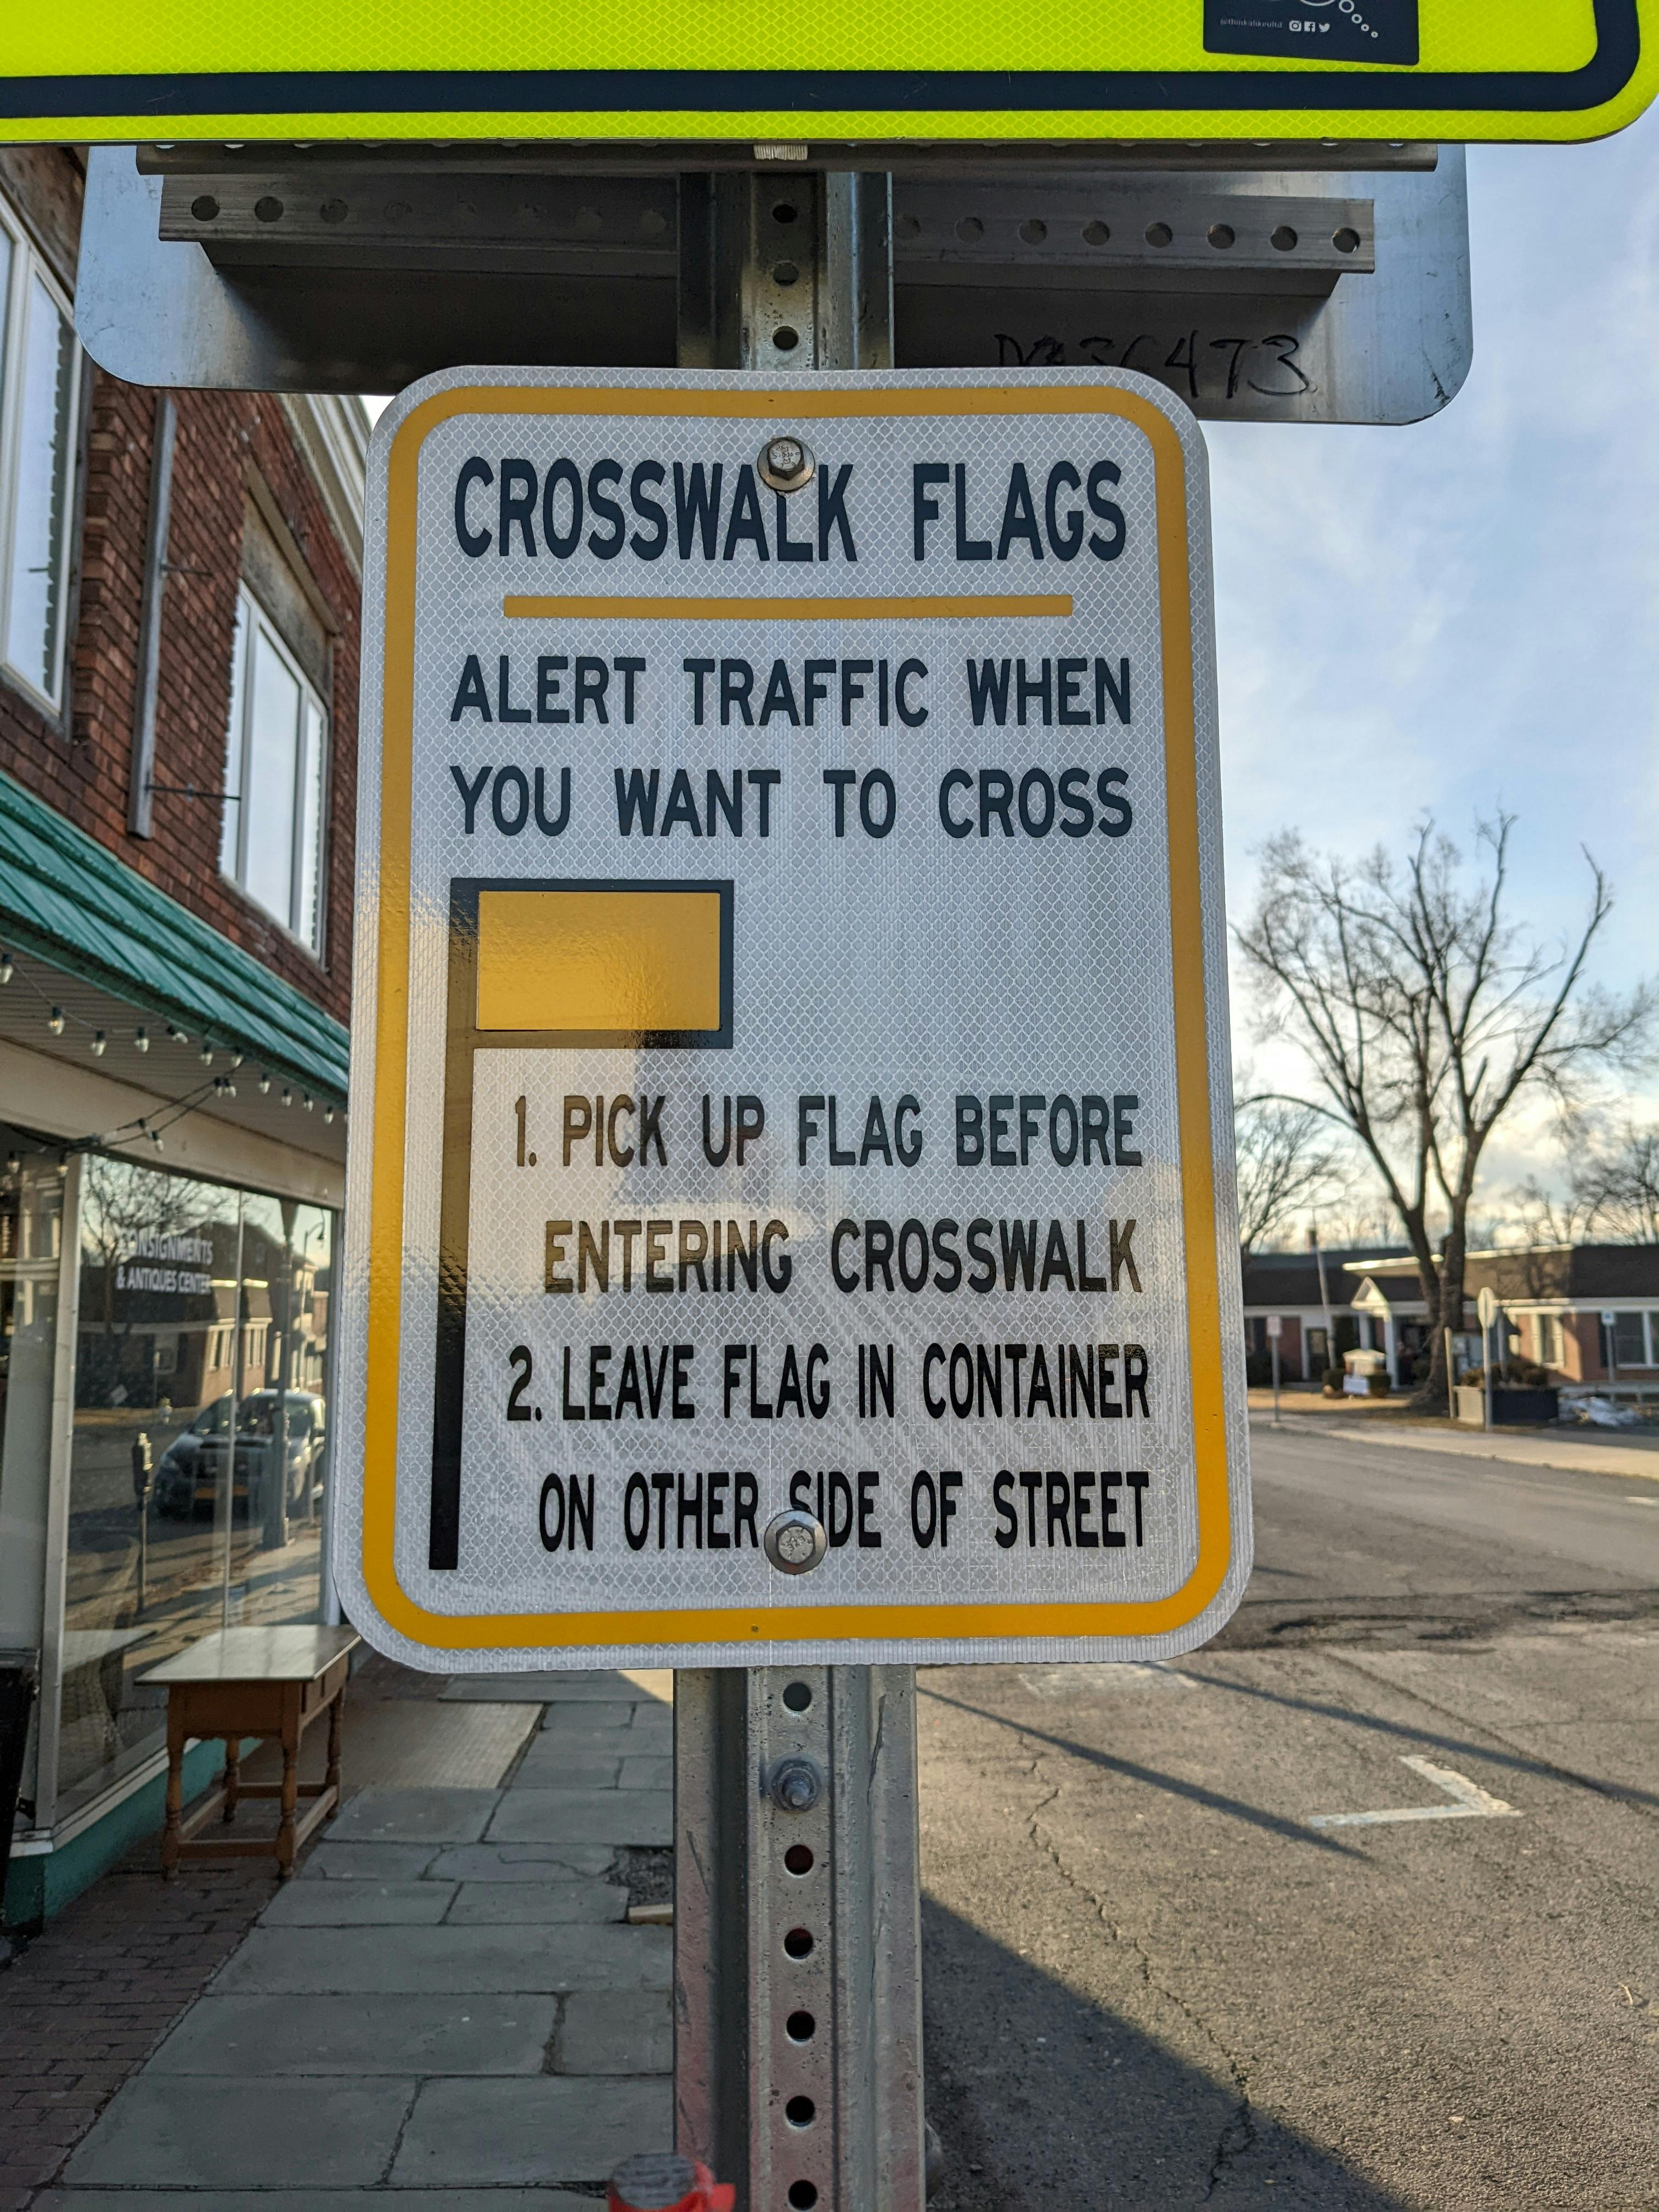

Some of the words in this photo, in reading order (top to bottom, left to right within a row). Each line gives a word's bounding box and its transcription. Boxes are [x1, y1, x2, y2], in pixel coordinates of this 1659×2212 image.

[455, 457, 857, 562] CROSSWALK
[913, 460, 1126, 561] FLAGS
[450, 655, 646, 724] ALERT
[683, 658, 929, 727] TRAFFIC
[966, 658, 1131, 726] WHEN
[449, 766, 571, 836] YOU
[614, 768, 781, 837] WANT
[823, 769, 896, 838] TO
[939, 768, 1132, 838] CROSS
[515, 1095, 537, 1166] 1.
[563, 1094, 668, 1167] PICK
[702, 1094, 765, 1167] UP
[799, 1094, 923, 1167] FLAG
[956, 1094, 1142, 1167] BEFORE
[116, 1265, 126, 1289] &
[127, 1267, 177, 1293] ANTIQUES
[177, 1271, 211, 1295] CENTER
[545, 1220, 792, 1294] ENTERING
[831, 1218, 1142, 1293] CROSSWALK
[506, 1345, 543, 1421] 2.
[562, 1345, 695, 1421] LEAVE
[724, 1344, 830, 1419] FLAG
[858, 1344, 894, 1418] IN
[923, 1343, 1150, 1419] CONTAINER
[539, 1473, 595, 1552] ON
[624, 1472, 759, 1550] OTHER
[789, 1470, 881, 1548] SIDE
[911, 1470, 963, 1548] OF
[994, 1470, 1149, 1548] STREET
